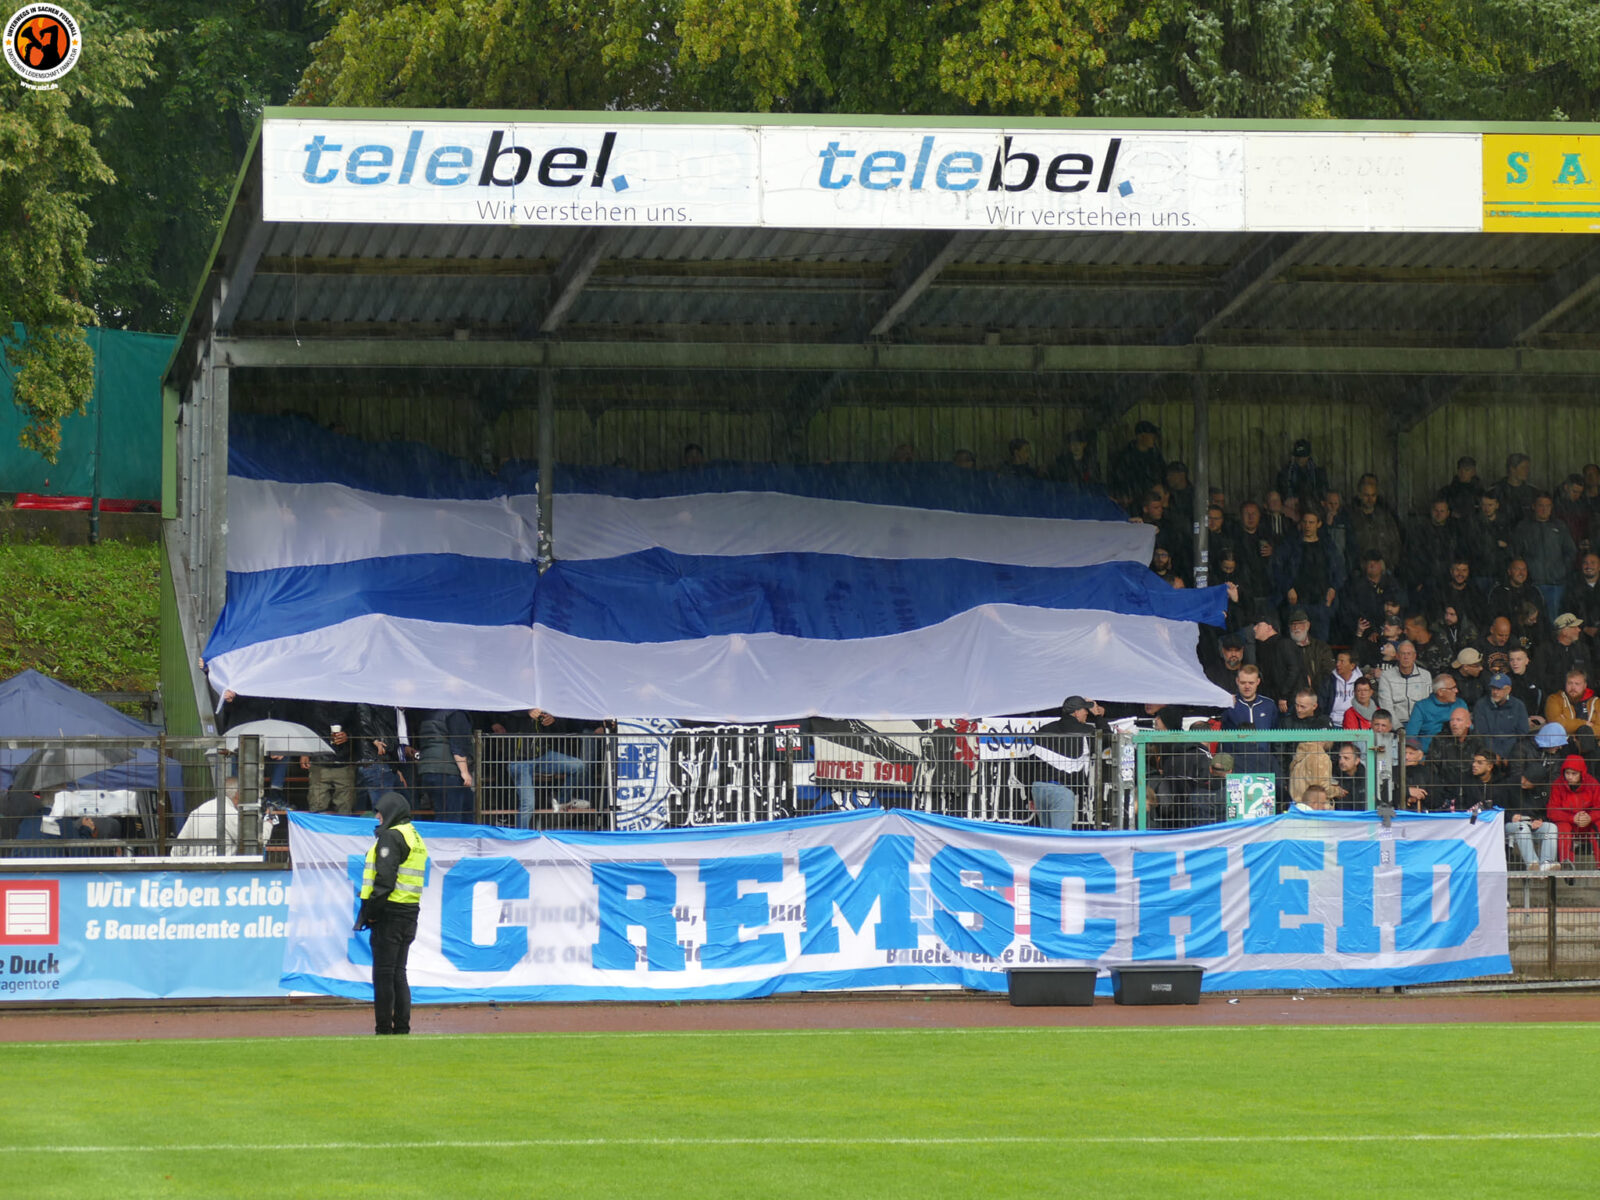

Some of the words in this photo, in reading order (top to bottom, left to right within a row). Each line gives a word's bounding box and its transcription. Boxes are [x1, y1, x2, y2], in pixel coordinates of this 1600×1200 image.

[477, 201, 515, 221] Wir
[524, 201, 636, 223] verstehen
[646, 206, 693, 222] uns.
[986, 205, 1028, 223] Wir
[1032, 206, 1141, 226] verstehen
[1152, 211, 1196, 226] uns.
[86, 881, 137, 908] Wir
[140, 879, 220, 907] lieben
[592, 834, 1479, 972] REMSCHEID
[85, 919, 101, 940] &
[105, 917, 240, 940] Bauelemente
[9, 952, 60, 974] Duck
[0, 979, 60, 993] agentore
